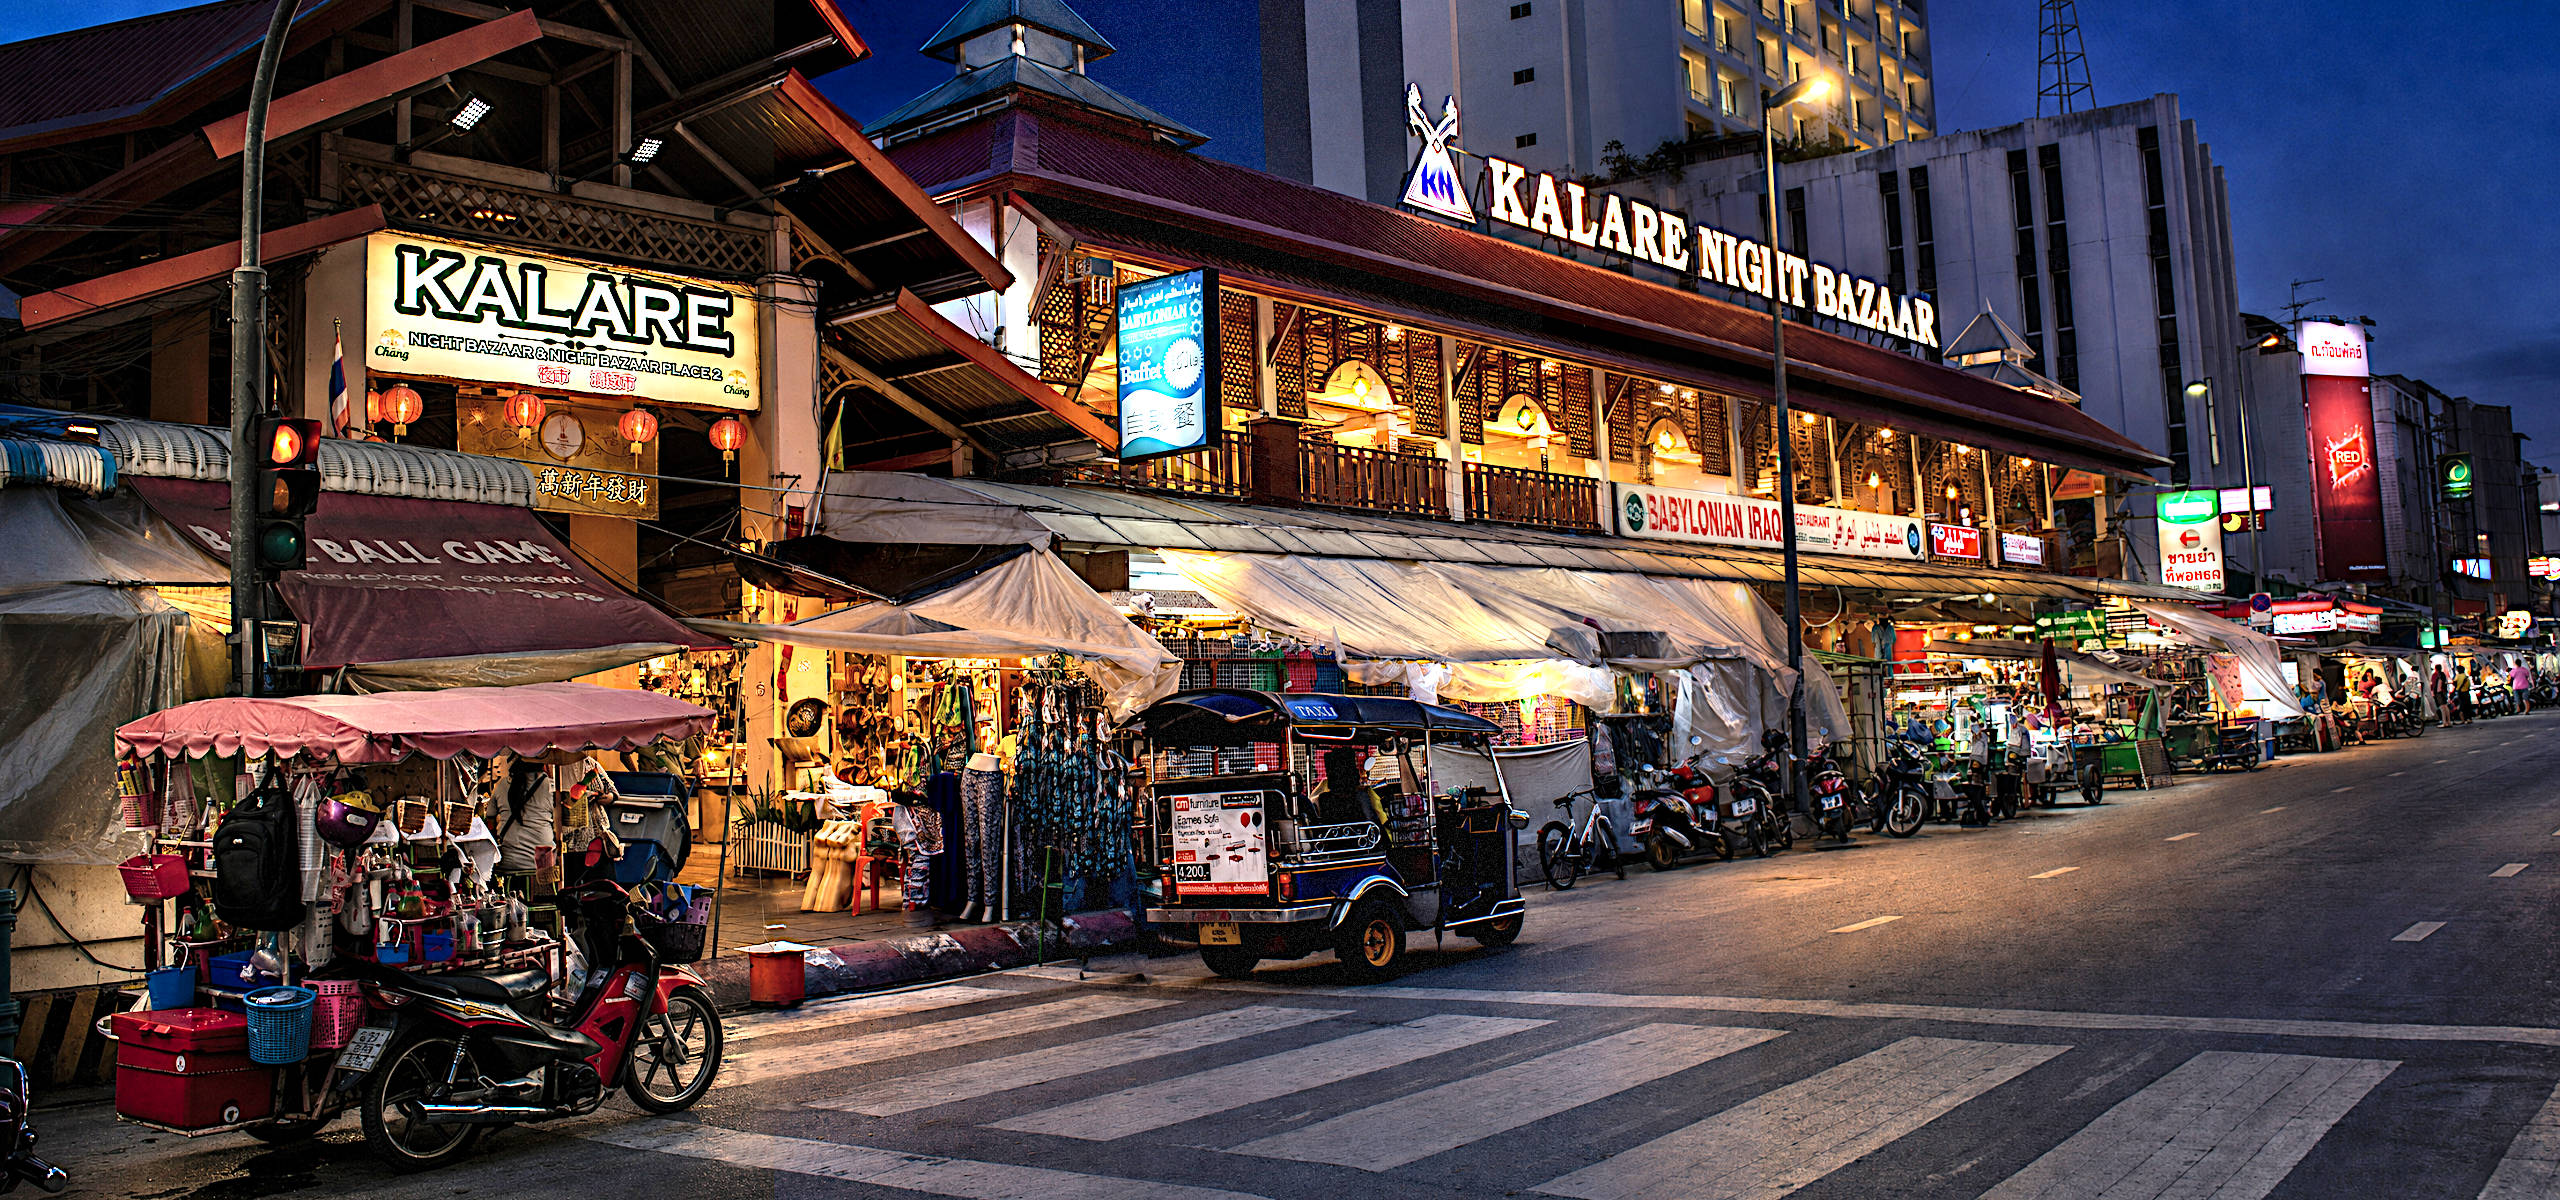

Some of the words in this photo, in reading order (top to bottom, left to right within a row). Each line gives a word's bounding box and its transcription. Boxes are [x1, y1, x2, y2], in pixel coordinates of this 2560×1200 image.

[1421, 162, 1455, 205] KN
[1489, 157, 1690, 271] KALARE
[1698, 225, 1809, 308] NIGHT
[1811, 263, 1939, 348] BAZAAR
[395, 244, 735, 358] KALARE
[1119, 303, 1187, 331] BABYLONIAN
[409, 331, 464, 351] NIGHT
[465, 338, 534, 359] BAZAAR
[535, 347, 548, 361] &
[549, 349, 596, 366] NIGHT
[600, 355, 660, 374] BAZAAR
[662, 362, 711, 380] PLACE
[712, 368, 723, 381] 2
[1120, 360, 1163, 386] Buffet
[2335, 450, 2361, 463] RED
[538, 468, 648, 503] 萬新年發財
[1646, 493, 1744, 538] BABYLONIAN
[1747, 505, 1783, 542] IRAQ
[1795, 513, 1830, 529] ESTAURANT
[312, 538, 442, 564] BALL
